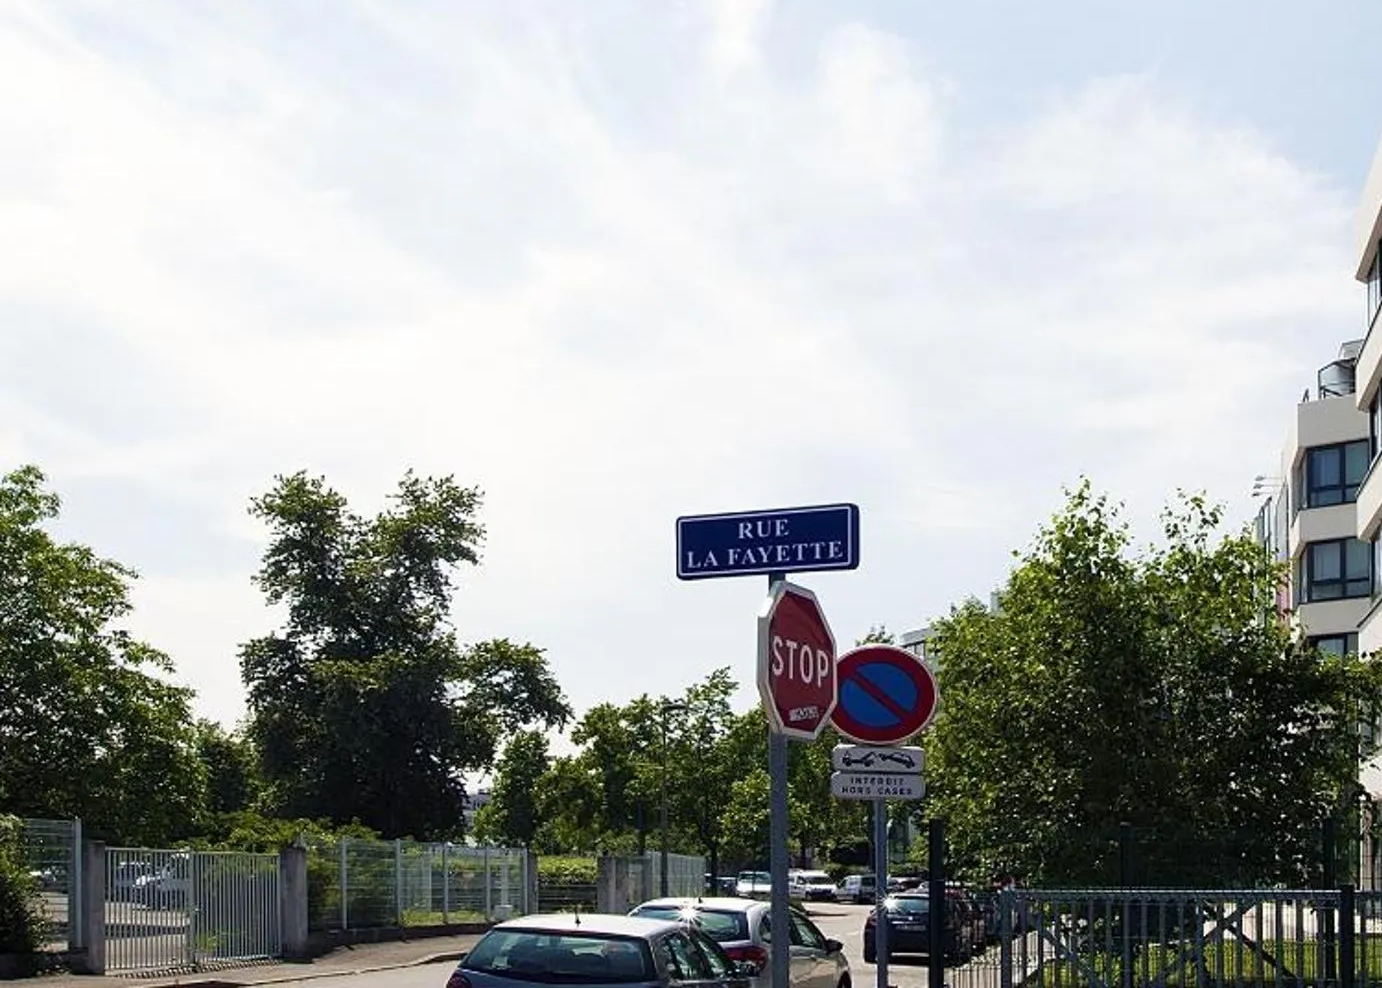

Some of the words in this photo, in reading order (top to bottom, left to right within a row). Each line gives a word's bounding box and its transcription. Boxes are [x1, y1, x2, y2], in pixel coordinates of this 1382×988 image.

[738, 519, 790, 539] RUE
[686, 550, 719, 568] LA
[727, 541, 844, 565] FAYETTE
[772, 635, 829, 688] STOP
[841, 786, 871, 794] HORS
[850, 777, 904, 786] INTERDIT
